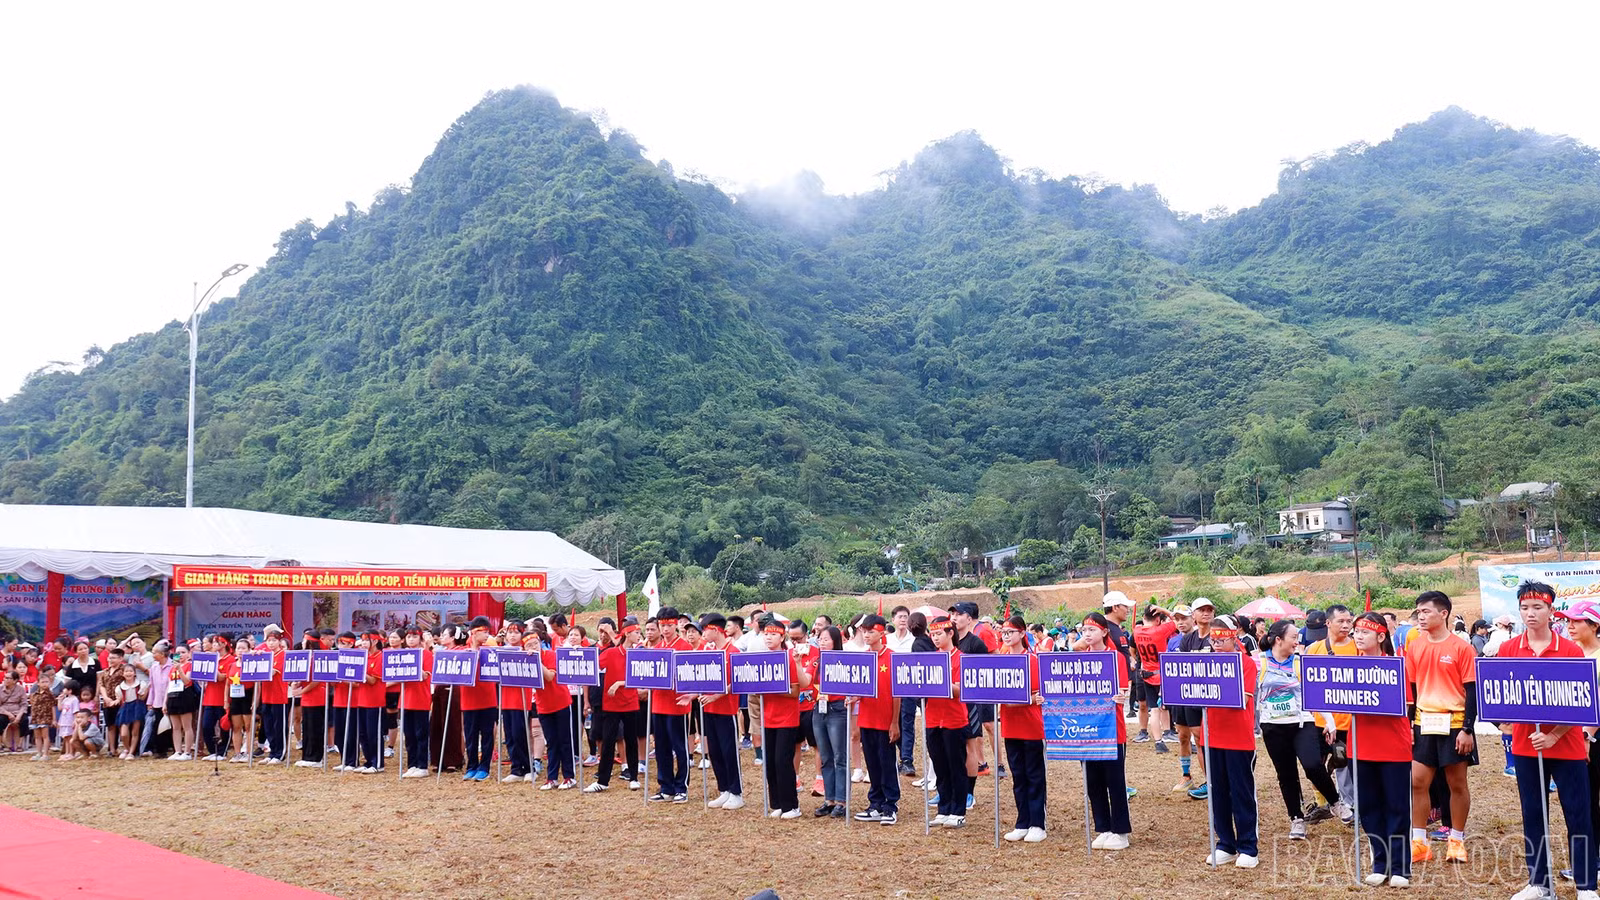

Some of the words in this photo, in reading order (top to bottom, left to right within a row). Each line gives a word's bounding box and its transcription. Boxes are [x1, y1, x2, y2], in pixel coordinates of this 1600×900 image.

[9, 584, 35, 593] GIAN
[38, 584, 67, 593] HG
[106, 584, 126, 594] BÀY
[184, 572, 213, 585] GIAN
[217, 570, 249, 585] HÀNG
[254, 572, 289, 586] TRƯNG
[292, 572, 313, 586] BÀY
[316, 572, 339, 586] SẢN
[340, 571, 371, 586] PHẨM
[374, 575, 401, 588] OCOP,
[428, 573, 455, 587] NĂNG
[456, 576, 471, 590] LỢI
[491, 574, 503, 588] XÃ
[504, 574, 522, 588] CỐC
[524, 577, 540, 588] SAN
[1554, 582, 1587, 600] hạm
[222, 611, 245, 619] GIAN
[247, 610, 272, 618] HÀNG
[436, 658, 446, 674] XÃ
[446, 656, 461, 675] BẮC
[461, 658, 471, 675] HÀ
[631, 660, 655, 681] TRỌNG
[656, 658, 669, 678] TÀI
[734, 660, 759, 683] PHƯỜNG
[760, 660, 773, 682] LÀO
[774, 663, 785, 682] CAI
[825, 660, 850, 683] PHƯỜNG
[852, 664, 861, 683] SA
[862, 665, 871, 684] PA
[896, 661, 910, 685] ĐỨC
[910, 662, 925, 689] VIỆT
[925, 664, 944, 685] LAND
[1051, 659, 1062, 675] CÂU
[1062, 661, 1074, 678] LẠC
[1074, 659, 1083, 678] BỘ
[1083, 661, 1090, 675] XE
[1090, 661, 1103, 678] ĐẠP
[1164, 662, 1178, 677] CLB
[1179, 662, 1193, 678] LEO
[1193, 660, 1206, 678] NÚI
[1206, 660, 1222, 678] LÀO
[1222, 663, 1235, 679] CAI
[964, 668, 977, 689] CLB
[978, 668, 994, 689] GYM
[995, 668, 1025, 689] BITEXCO
[1306, 667, 1328, 683] CLB
[1332, 668, 1354, 684] TAM
[1357, 666, 1398, 686] ĐƯỜNG
[1044, 680, 1062, 694] THÀNH
[1062, 678, 1074, 694] PHỐ
[1074, 680, 1086, 694] LÀO
[1086, 681, 1097, 694] CAI
[1097, 681, 1112, 695] (LCC)
[1180, 684, 1221, 701] (CLIMCLUB)
[1483, 680, 1501, 705] CLB
[1504, 672, 1522, 705] BẢO
[1524, 674, 1543, 706] YÊN
[1545, 680, 1591, 708] RUNNERS
[1324, 689, 1380, 707] RUNNERS
